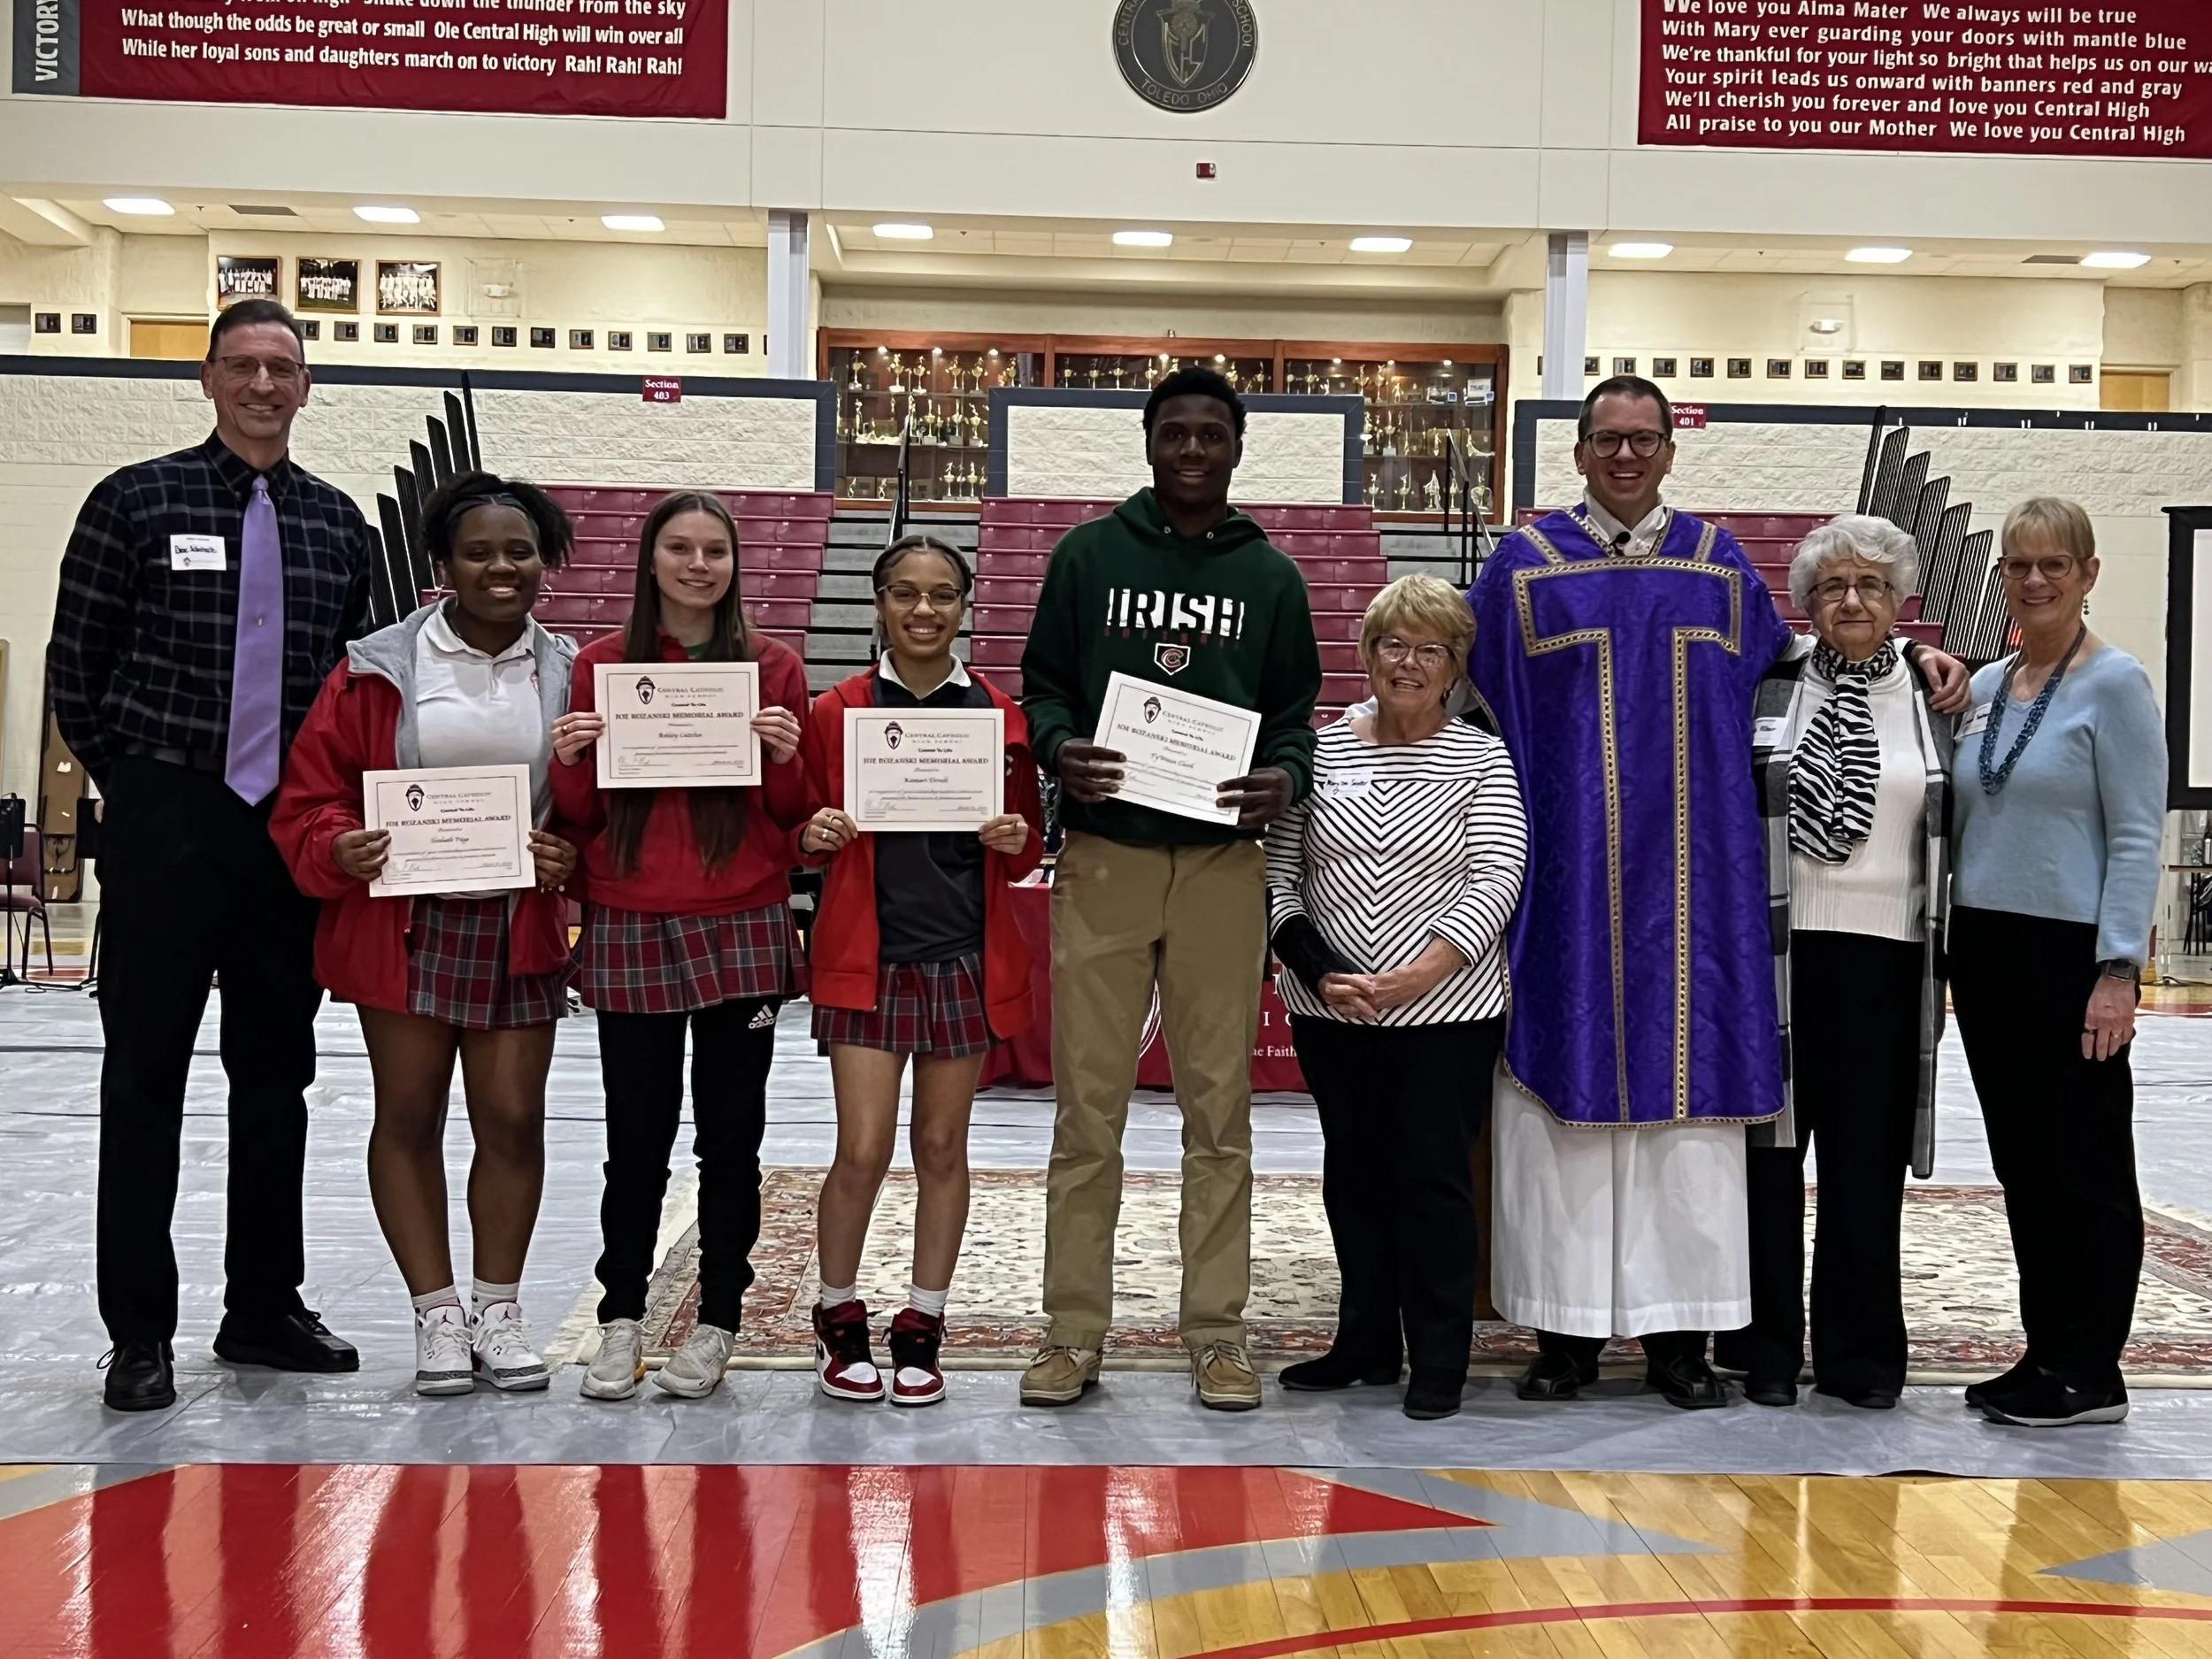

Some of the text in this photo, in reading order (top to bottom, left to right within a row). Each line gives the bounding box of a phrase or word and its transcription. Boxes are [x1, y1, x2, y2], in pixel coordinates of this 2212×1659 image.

[579, 0, 619, 14] from
[625, 0, 652, 15] the
[657, 0, 687, 20] sky
[1663, 0, 2137, 27] We love you Alma Mater We always will be true
[121, 8, 684, 46] What though the odds be great or small Ole Central High will win over all
[1662, 19, 2186, 50] With Mary ever guarding your doors with mantle blue
[122, 38, 683, 77] While her loyal sons and daughters march on to victory Rah! Rah! Rah!
[1662, 43, 1711, 62] We're
[1717, 46, 1790, 63] thankful
[1796, 46, 1823, 64] for
[1827, 51, 1869, 68] your
[1873, 49, 1914, 70] light
[1918, 53, 1939, 66] so
[1947, 51, 2002, 73] bright
[2007, 53, 2043, 69] that
[2049, 53, 2097, 74] helps
[2104, 58, 2124, 71] us
[2130, 59, 2152, 73] on
[2157, 60, 2189, 73] our
[1141, 78, 1228, 105] TOLEDO OHIO
[1664, 67, 2183, 100] Your spirit leads us onward with banners red and gray
[1665, 90, 2150, 122] We'll cherish you forever and love you Central High
[1665, 113, 2185, 146] All praise to you our Mother We love you Central High
[645, 380, 680, 389] Section
[654, 391, 670, 400] 403
[1671, 405, 1704, 415] Section
[1678, 417, 1694, 426] 401
[1107, 588, 1245, 641] IRISH
[1163, 711, 1191, 724] CENTRAL
[1117, 724, 1130, 733] JOE
[1131, 727, 1169, 743] ROZANSKI
[1169, 737, 1209, 754] MEMORIAL
[1210, 749, 1236, 761] AWARD
[1267, 1045, 1297, 1057] Faith
